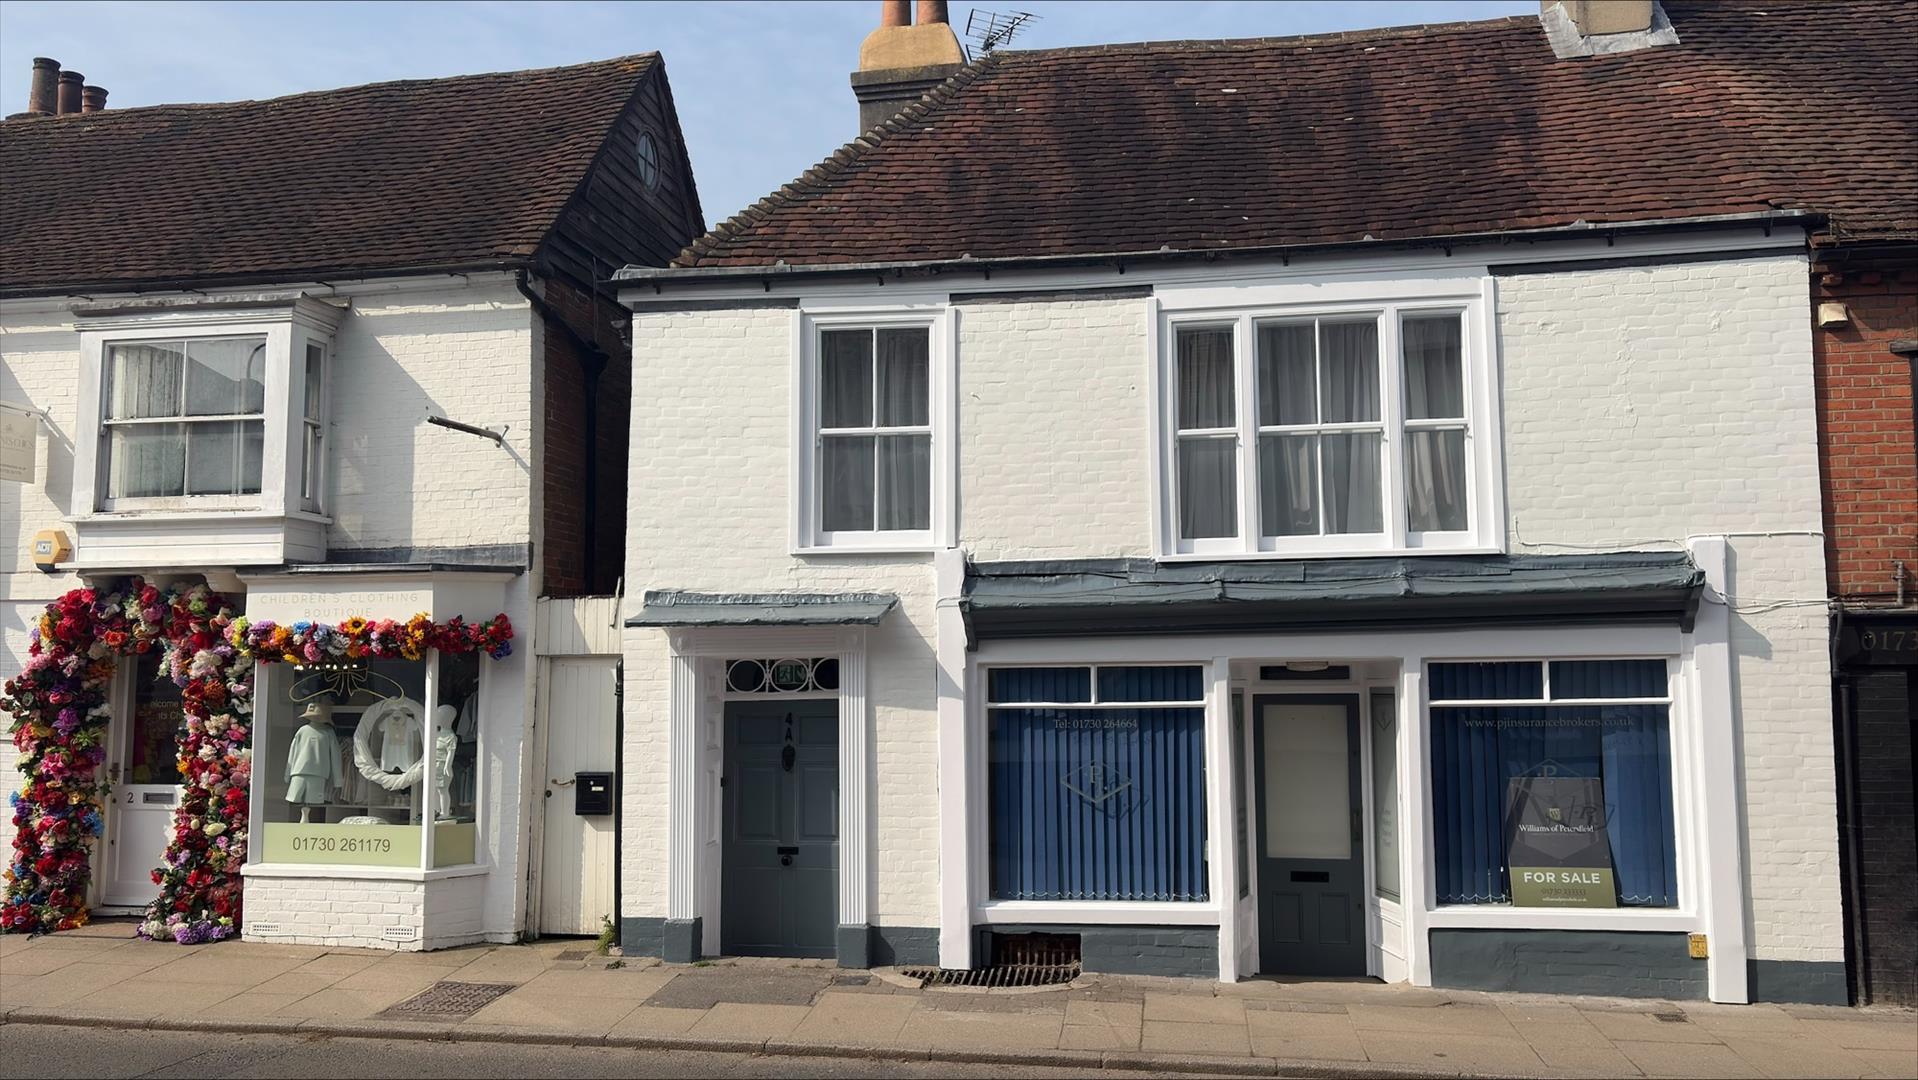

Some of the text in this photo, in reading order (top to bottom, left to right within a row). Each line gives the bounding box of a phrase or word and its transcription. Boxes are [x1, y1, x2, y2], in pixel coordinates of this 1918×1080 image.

[350, 592, 418, 603] CLOTHING
[304, 607, 373, 618] BOUTIQUE
[1055, 719, 1138, 729] Tel: 01730 264664
[127, 792, 134, 804] 2
[1518, 823, 1594, 833] Williams of Petersfield
[292, 836, 391, 852] 01730 261179
[1524, 872, 1601, 884] FOR SALE
